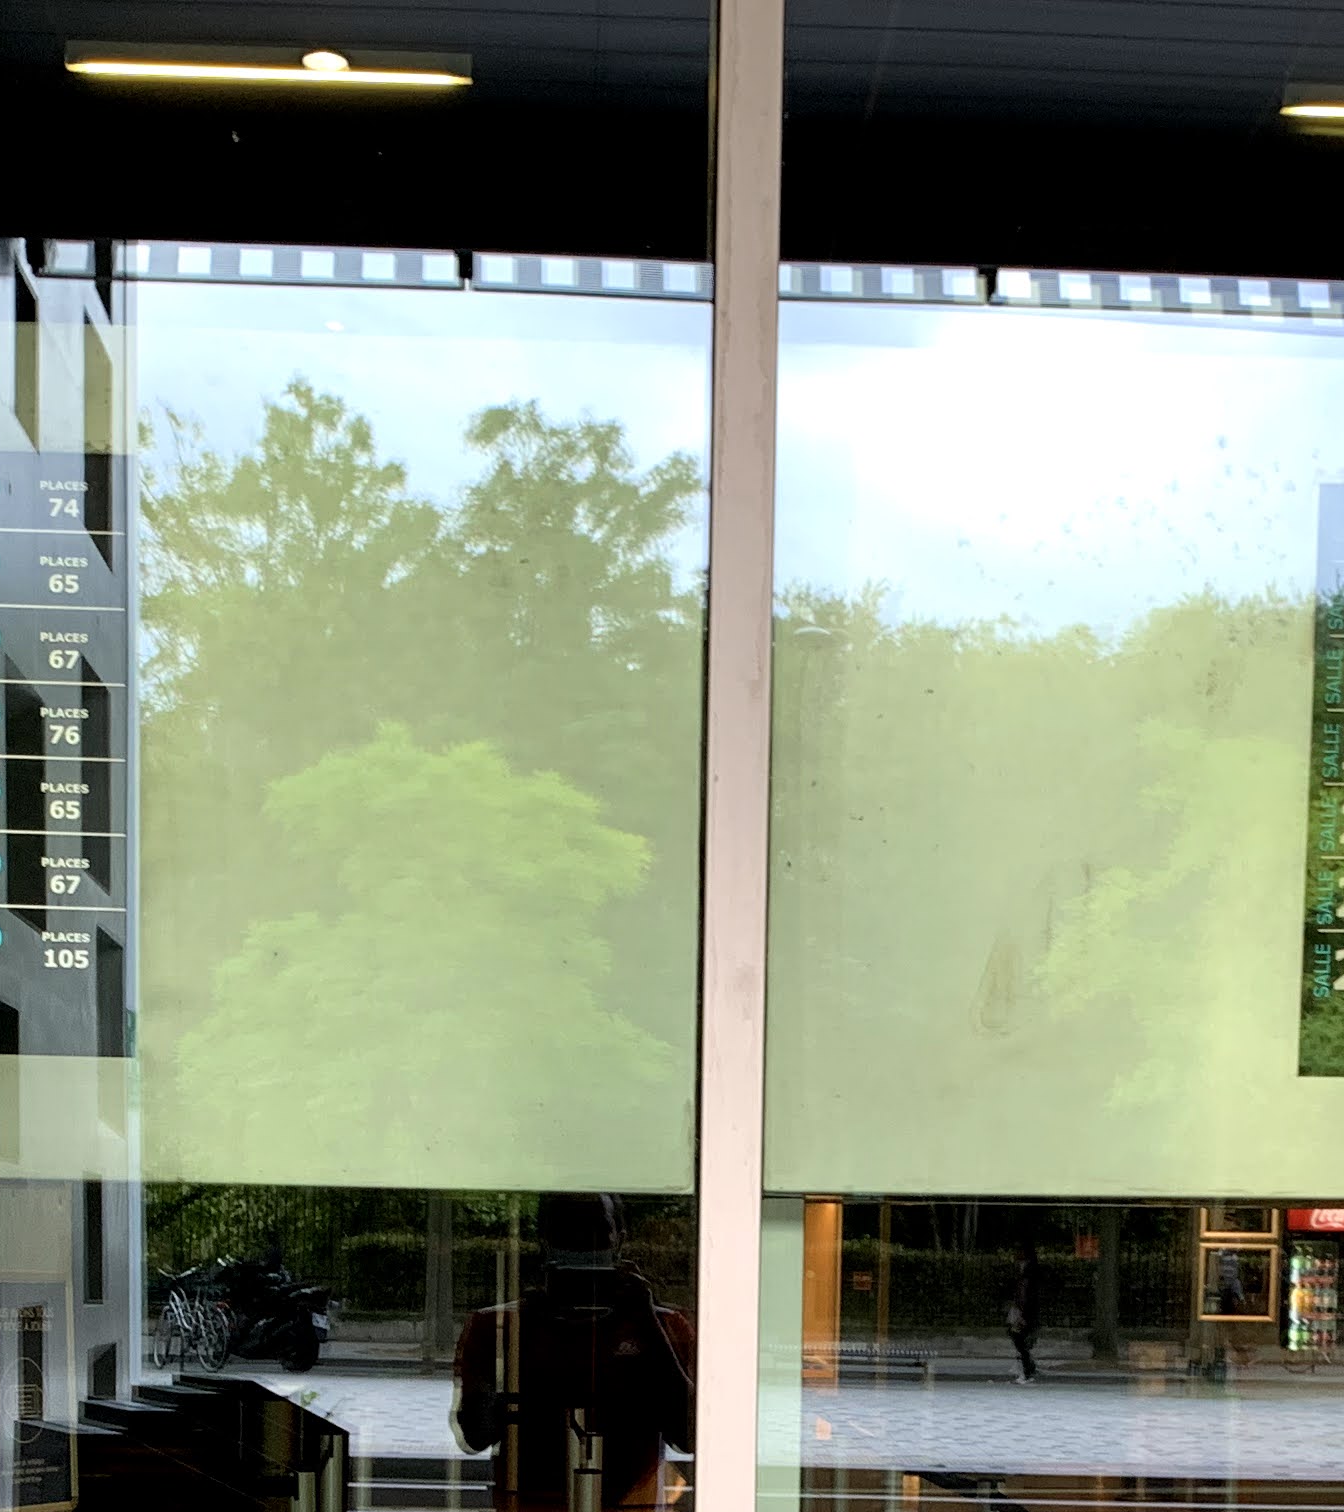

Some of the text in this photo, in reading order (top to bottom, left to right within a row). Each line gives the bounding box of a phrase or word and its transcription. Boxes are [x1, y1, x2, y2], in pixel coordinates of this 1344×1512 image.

[48, 498, 79, 517] 74
[48, 574, 79, 594] 65
[48, 649, 79, 669] 67
[49, 725, 80, 745] 76
[49, 801, 81, 820] 65
[50, 875, 82, 894] 67
[43, 949, 89, 969] 105
